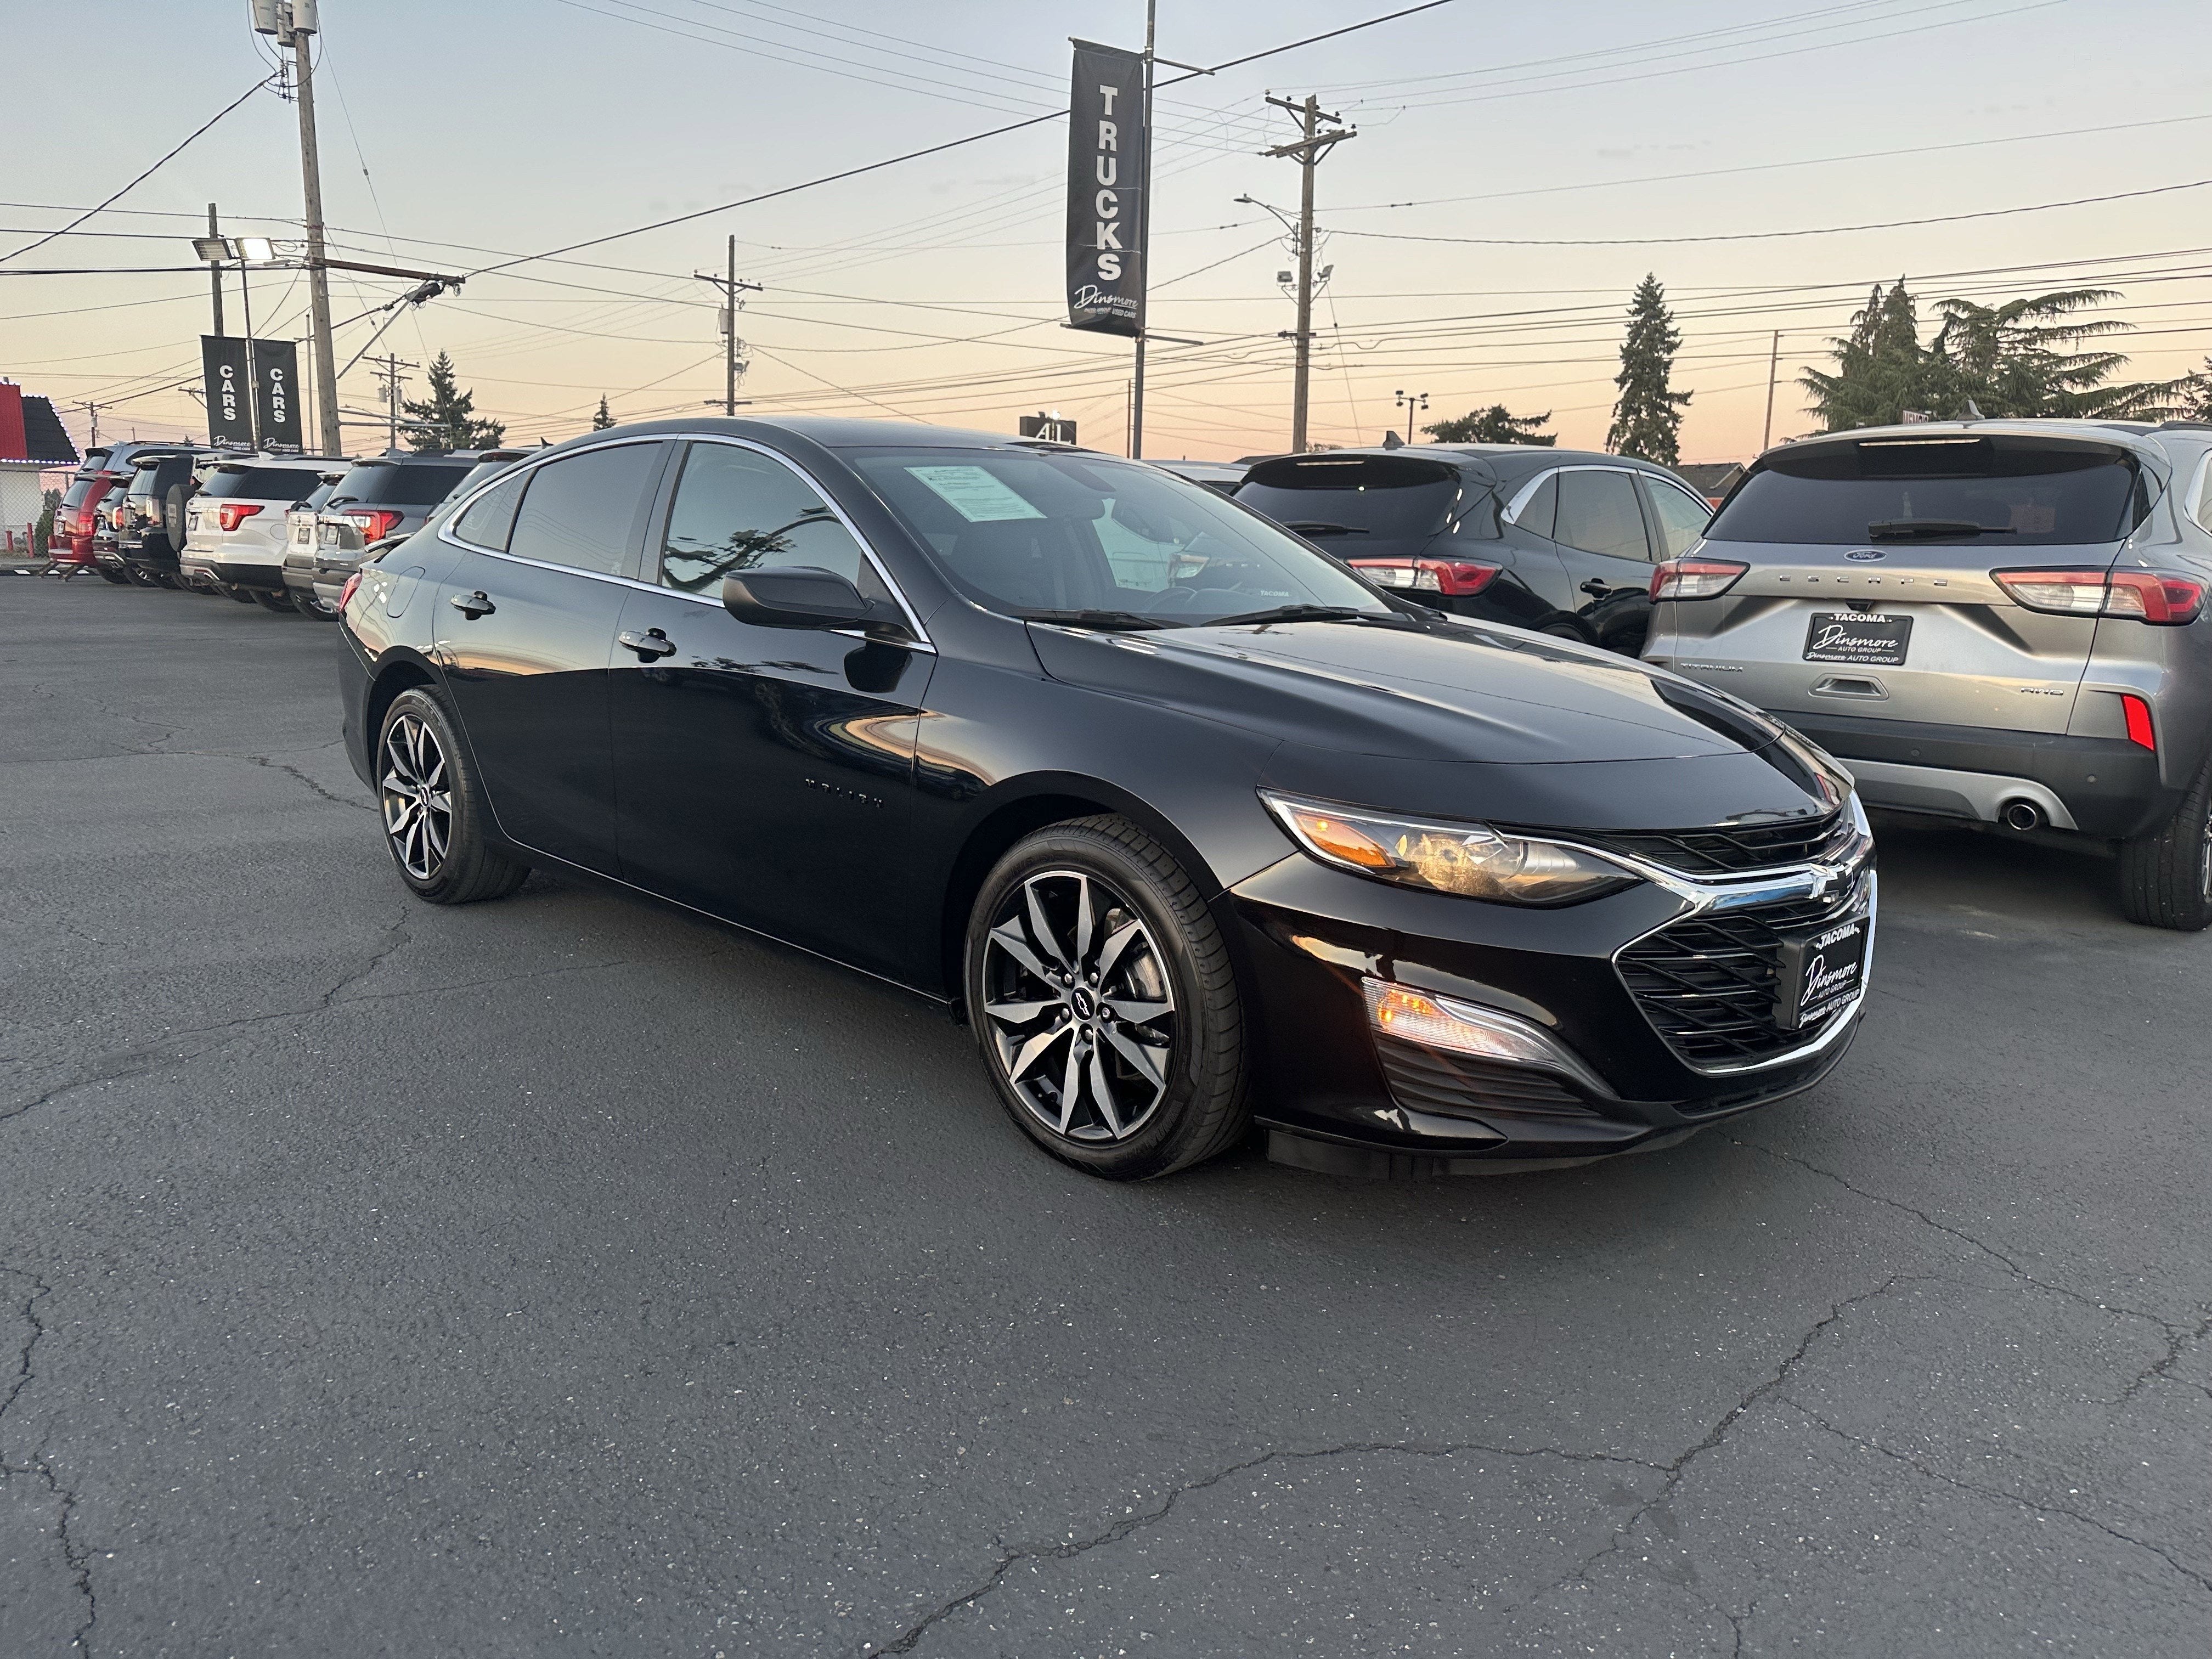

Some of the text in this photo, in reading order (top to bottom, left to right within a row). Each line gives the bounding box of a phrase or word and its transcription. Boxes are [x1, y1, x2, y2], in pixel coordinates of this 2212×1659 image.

[1096, 84, 1123, 281] TRUCKS
[1074, 284, 1139, 309] Dinsmore
[219, 365, 236, 421] CARS
[269, 368, 286, 423] CARS
[1852, 551, 1877, 559] Ford
[1779, 575, 1948, 586] ESCAPE
[1833, 613, 1886, 623] TACOMA
[1813, 624, 1899, 650] Dinsmore
[1819, 923, 1855, 950] TACOMA
[1800, 954, 1858, 1006] Dinsmore
[1817, 979, 1847, 1000] AUTO GROUP
[1826, 997, 1841, 1012] AUTO
[1841, 988, 1860, 1005] GROUP
